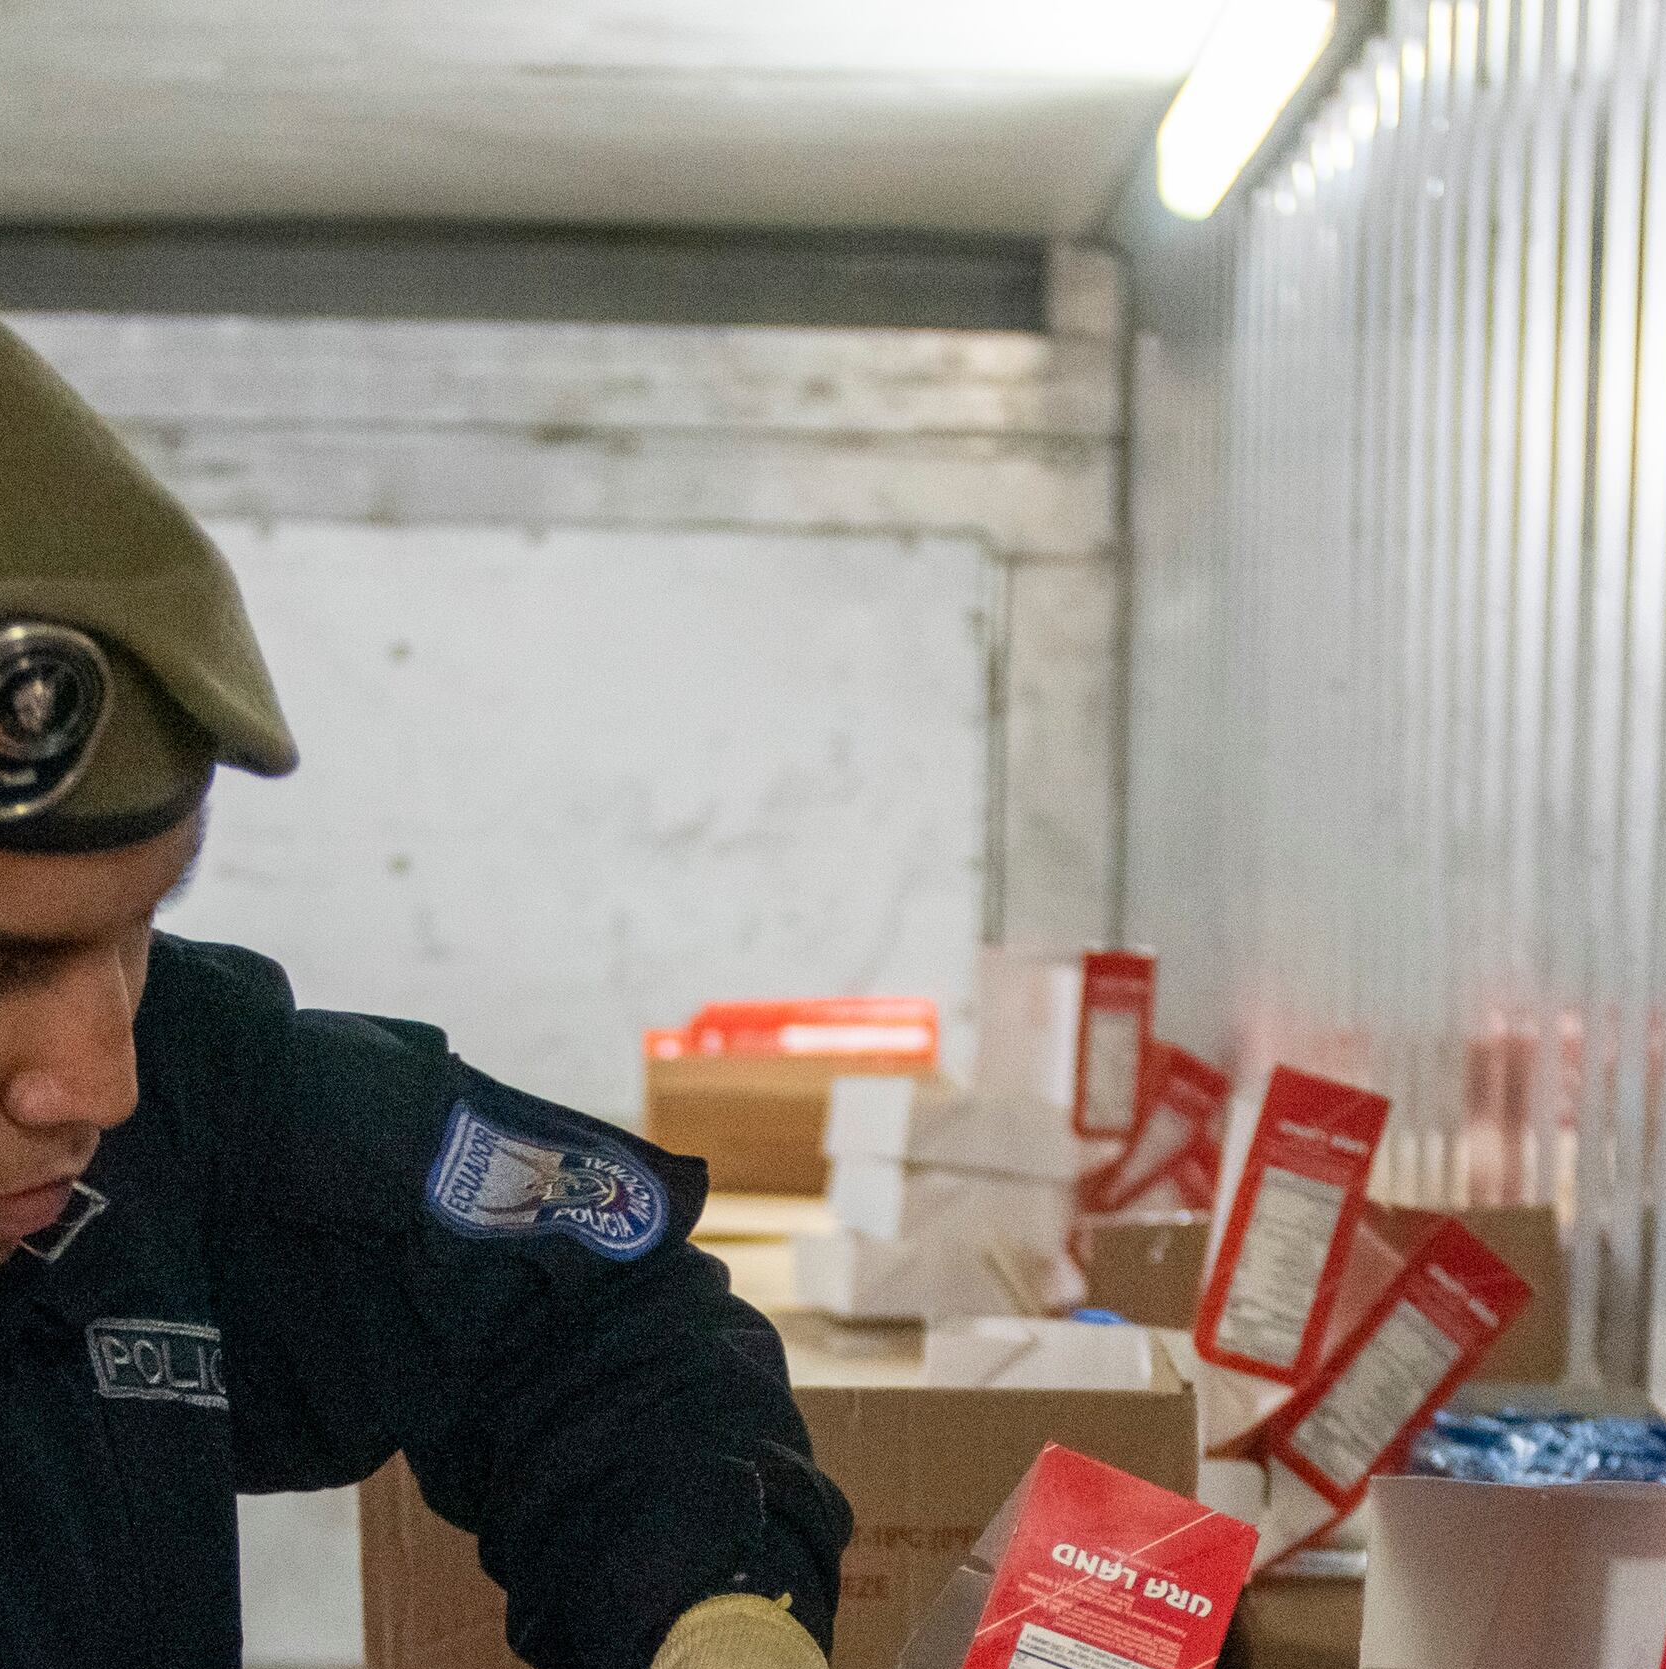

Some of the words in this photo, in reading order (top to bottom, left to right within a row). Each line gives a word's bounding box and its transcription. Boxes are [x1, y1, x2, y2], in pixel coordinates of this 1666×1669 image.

[449, 1127, 498, 1213] ECUADOR
[553, 1207, 633, 1238] POLICIA
[1052, 1543, 1138, 1590] LAND
[1143, 1576, 1213, 1618] URA
